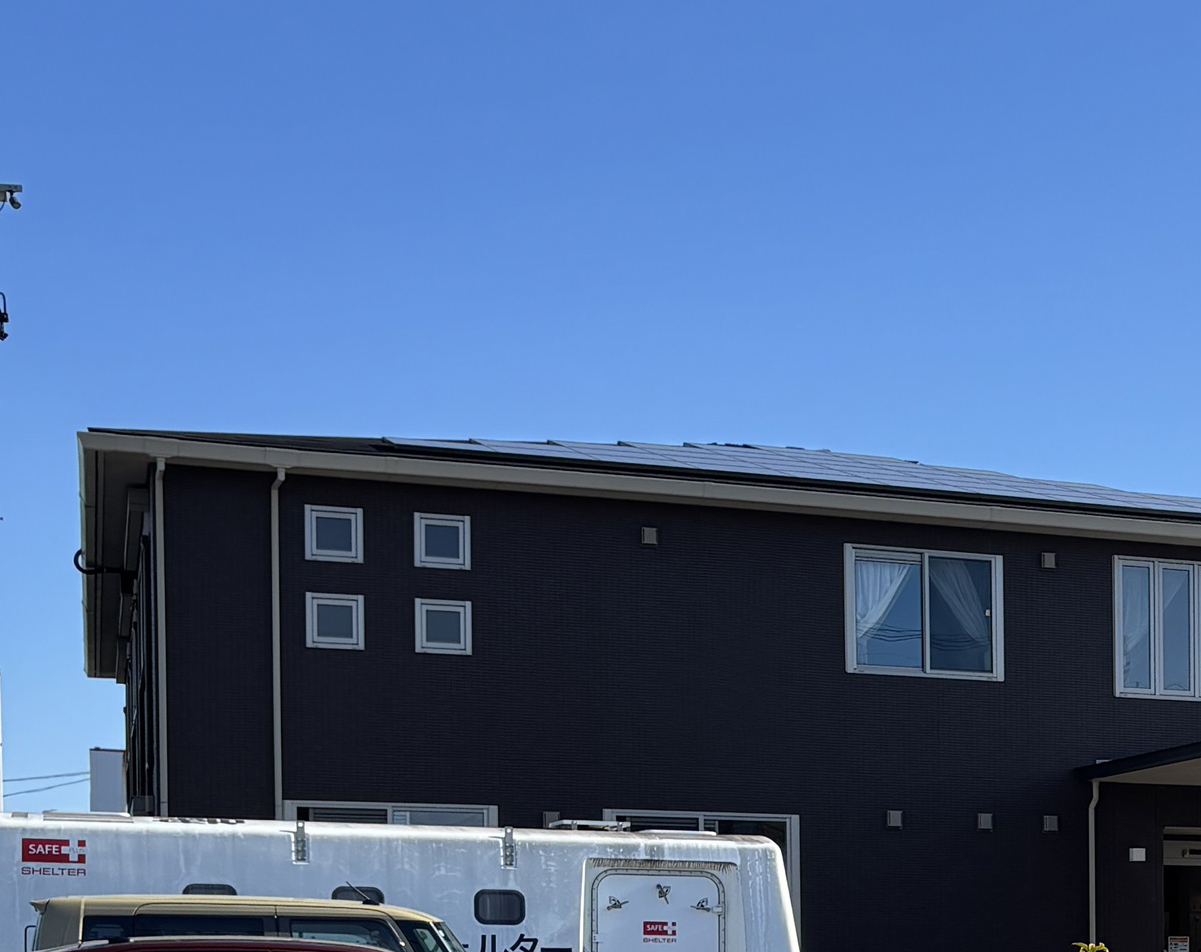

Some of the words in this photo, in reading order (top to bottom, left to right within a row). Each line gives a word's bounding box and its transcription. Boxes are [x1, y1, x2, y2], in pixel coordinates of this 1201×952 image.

[28, 843, 60, 855] SAFE
[21, 866, 87, 877] SHELTER
[646, 924, 663, 932] SAFE
